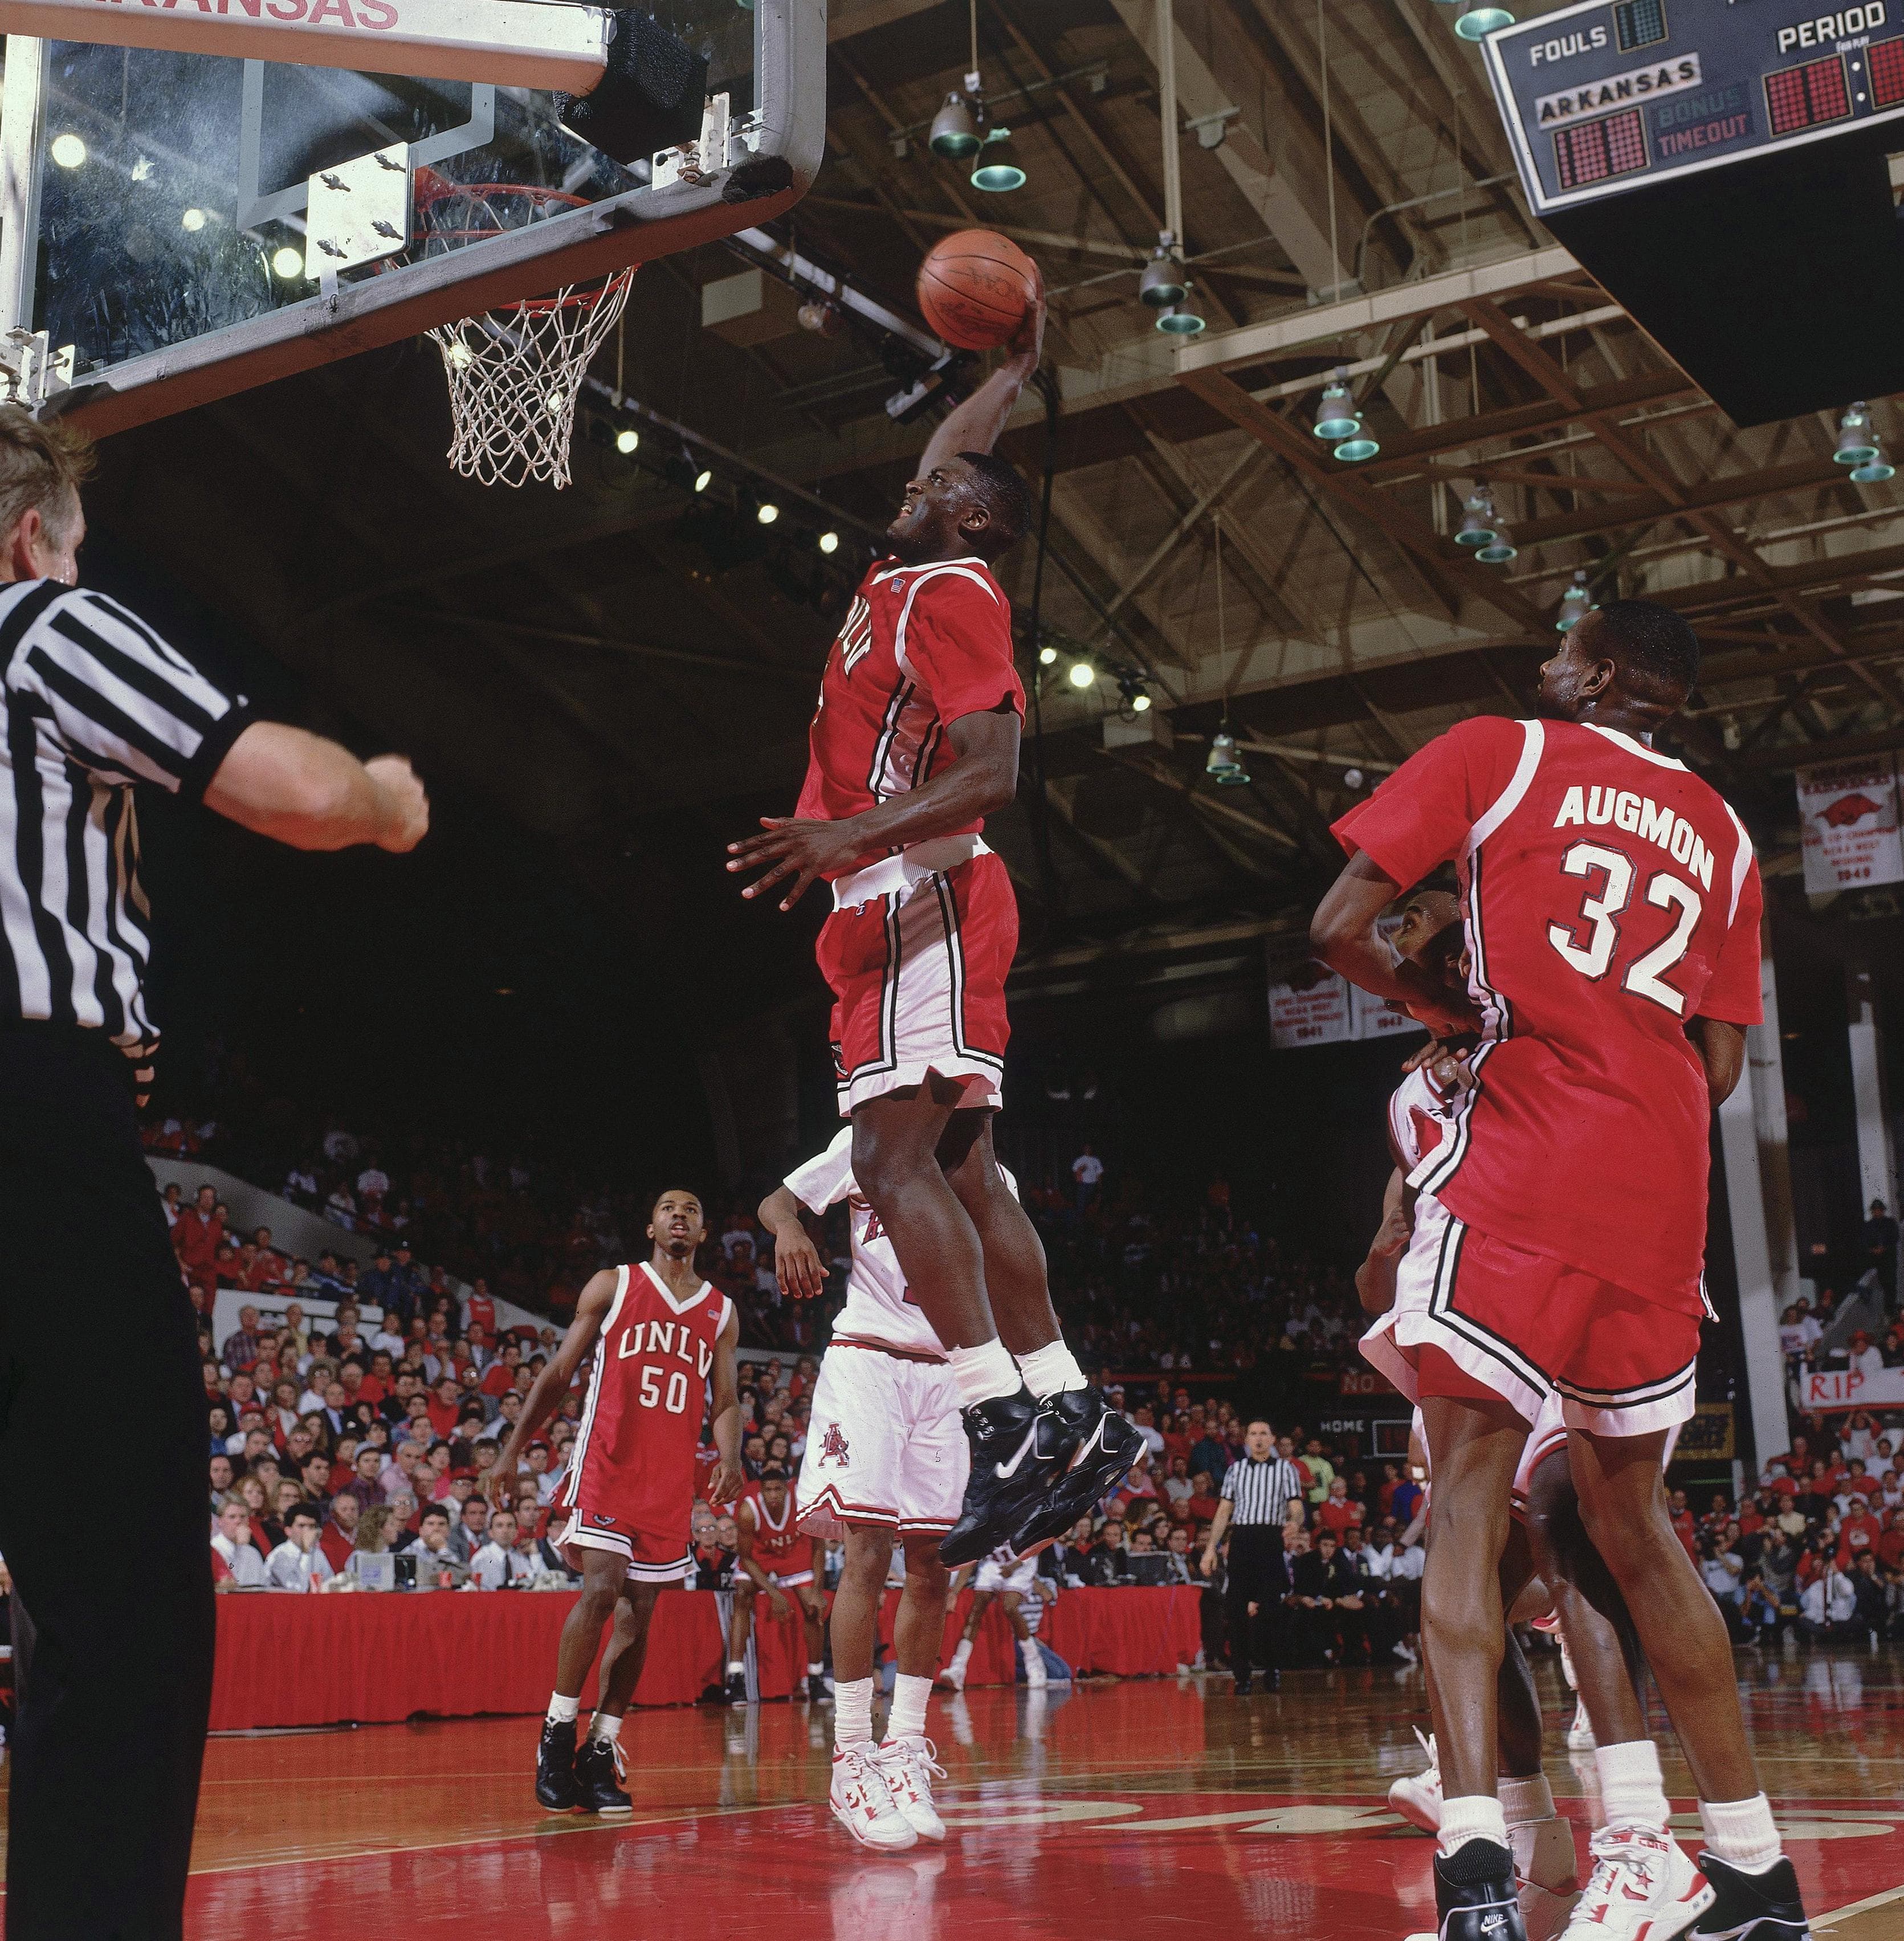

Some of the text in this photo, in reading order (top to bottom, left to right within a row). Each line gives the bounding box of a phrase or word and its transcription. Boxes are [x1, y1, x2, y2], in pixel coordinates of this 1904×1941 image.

[1530, 26, 1608, 67] FOULS
[1777, 1, 1885, 54] PERIOD
[1540, 62, 1694, 122] ARKANSAS
[1658, 87, 1743, 127] BONUS
[1658, 114, 1747, 156] TIMEOUT
[1554, 786, 1714, 892] AUGMON
[1547, 838, 1703, 1018] 32
[618, 1320, 714, 1379] UNLV
[638, 1365, 688, 1414] 50
[1810, 1370, 1865, 1402] RIP
[1320, 1420, 1364, 1433] HOME
[1483, 1913, 1504, 1926] NIKE
